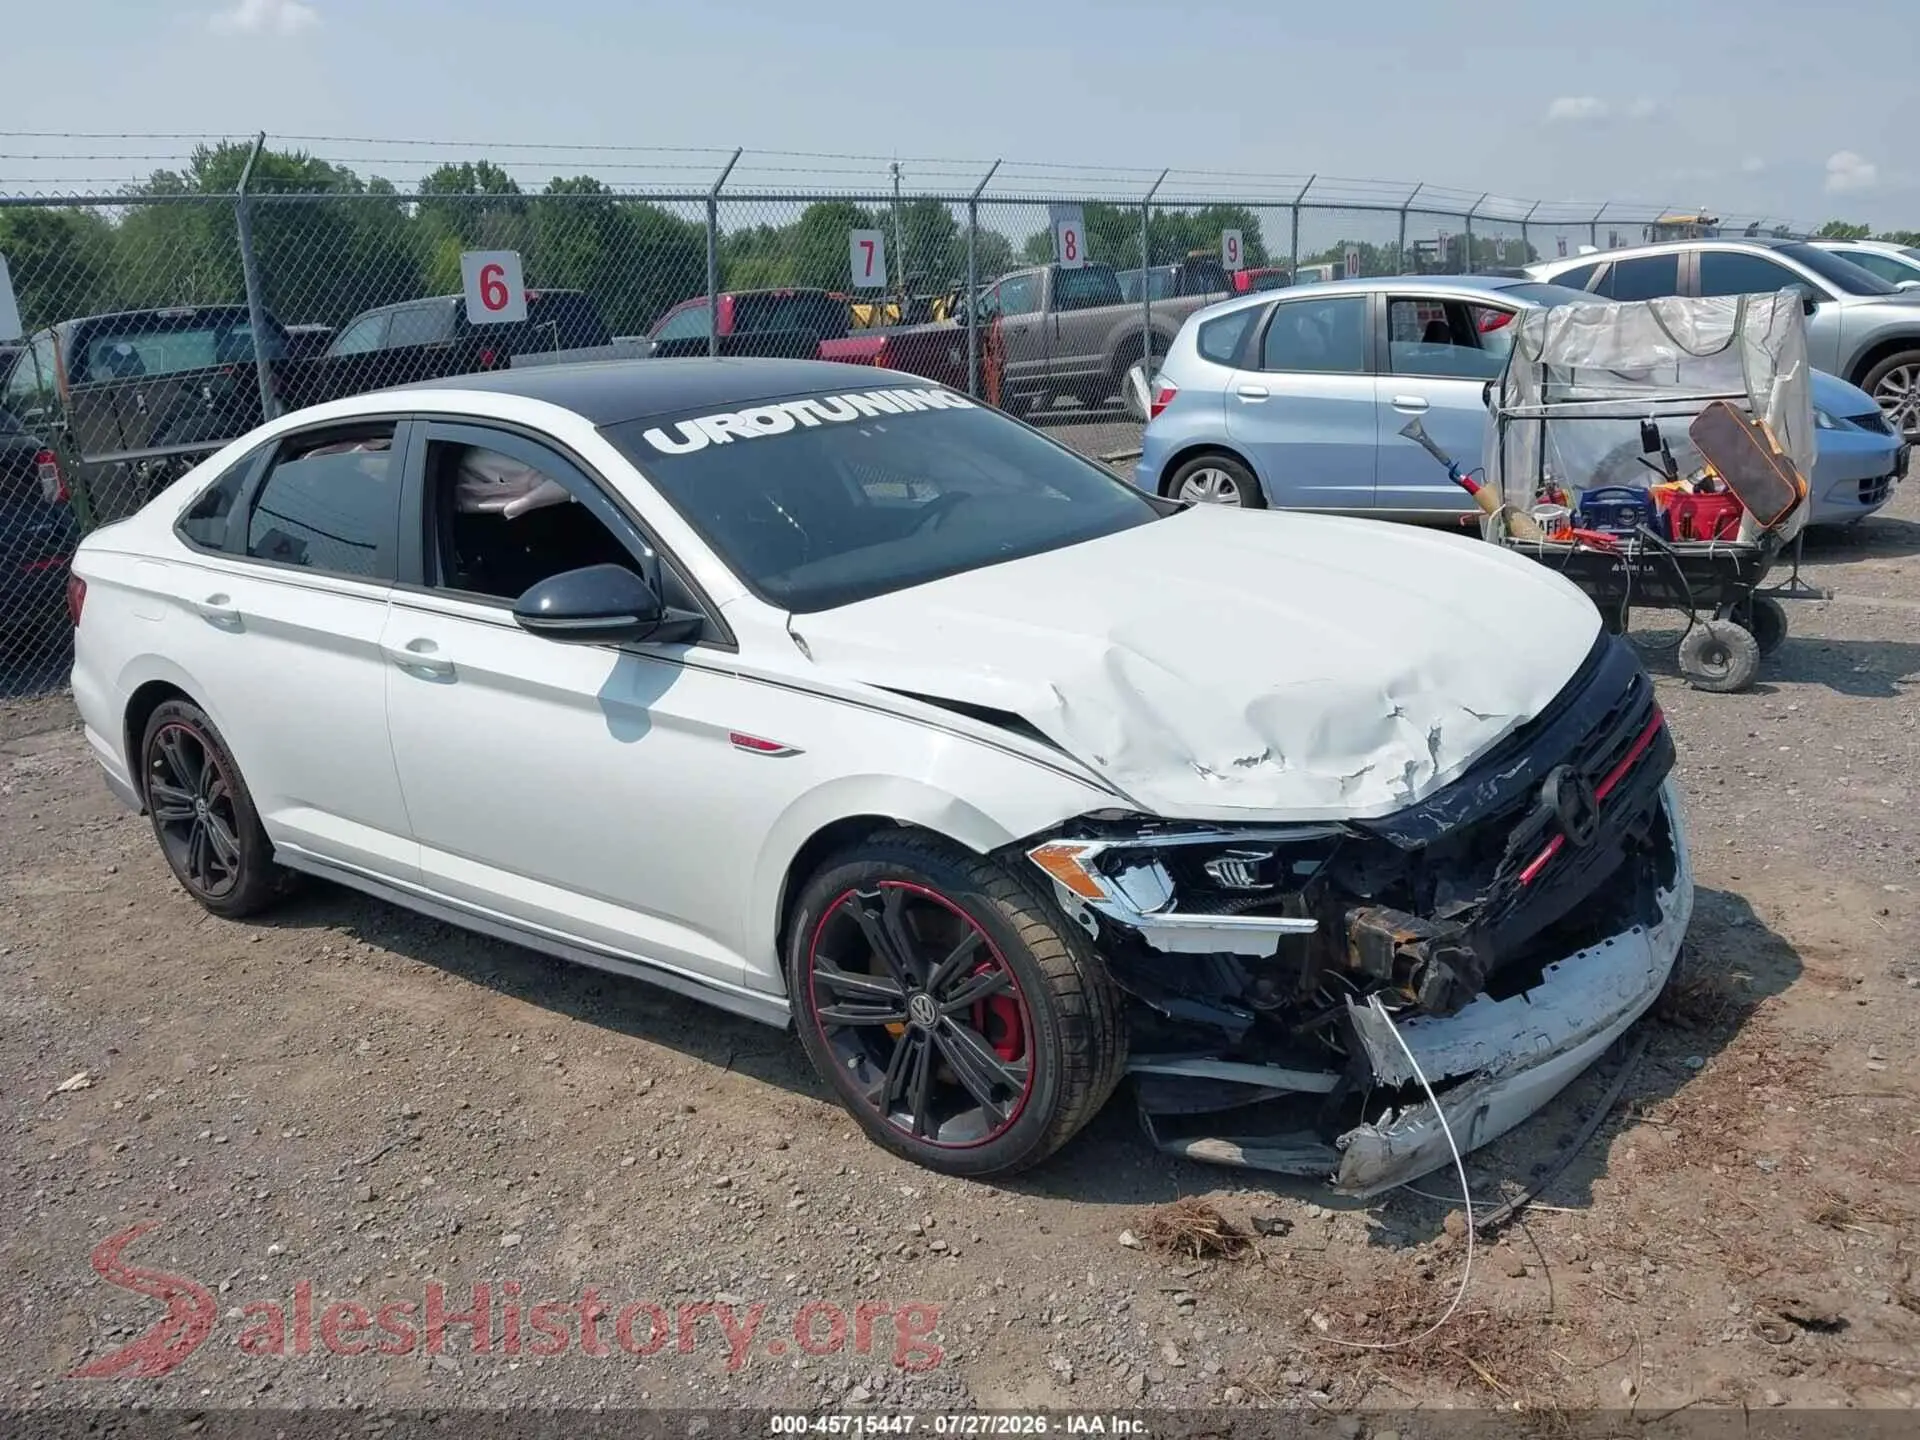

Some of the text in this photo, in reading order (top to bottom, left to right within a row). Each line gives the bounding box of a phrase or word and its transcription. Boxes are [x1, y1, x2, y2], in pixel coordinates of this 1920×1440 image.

[860, 240, 874, 277] 7
[1065, 230, 1076, 260] 8
[1228, 238, 1238, 263] 9
[1346, 253, 1358, 274] 10
[480, 263, 509, 311] 6
[643, 389, 980, 454] UROTUNING
